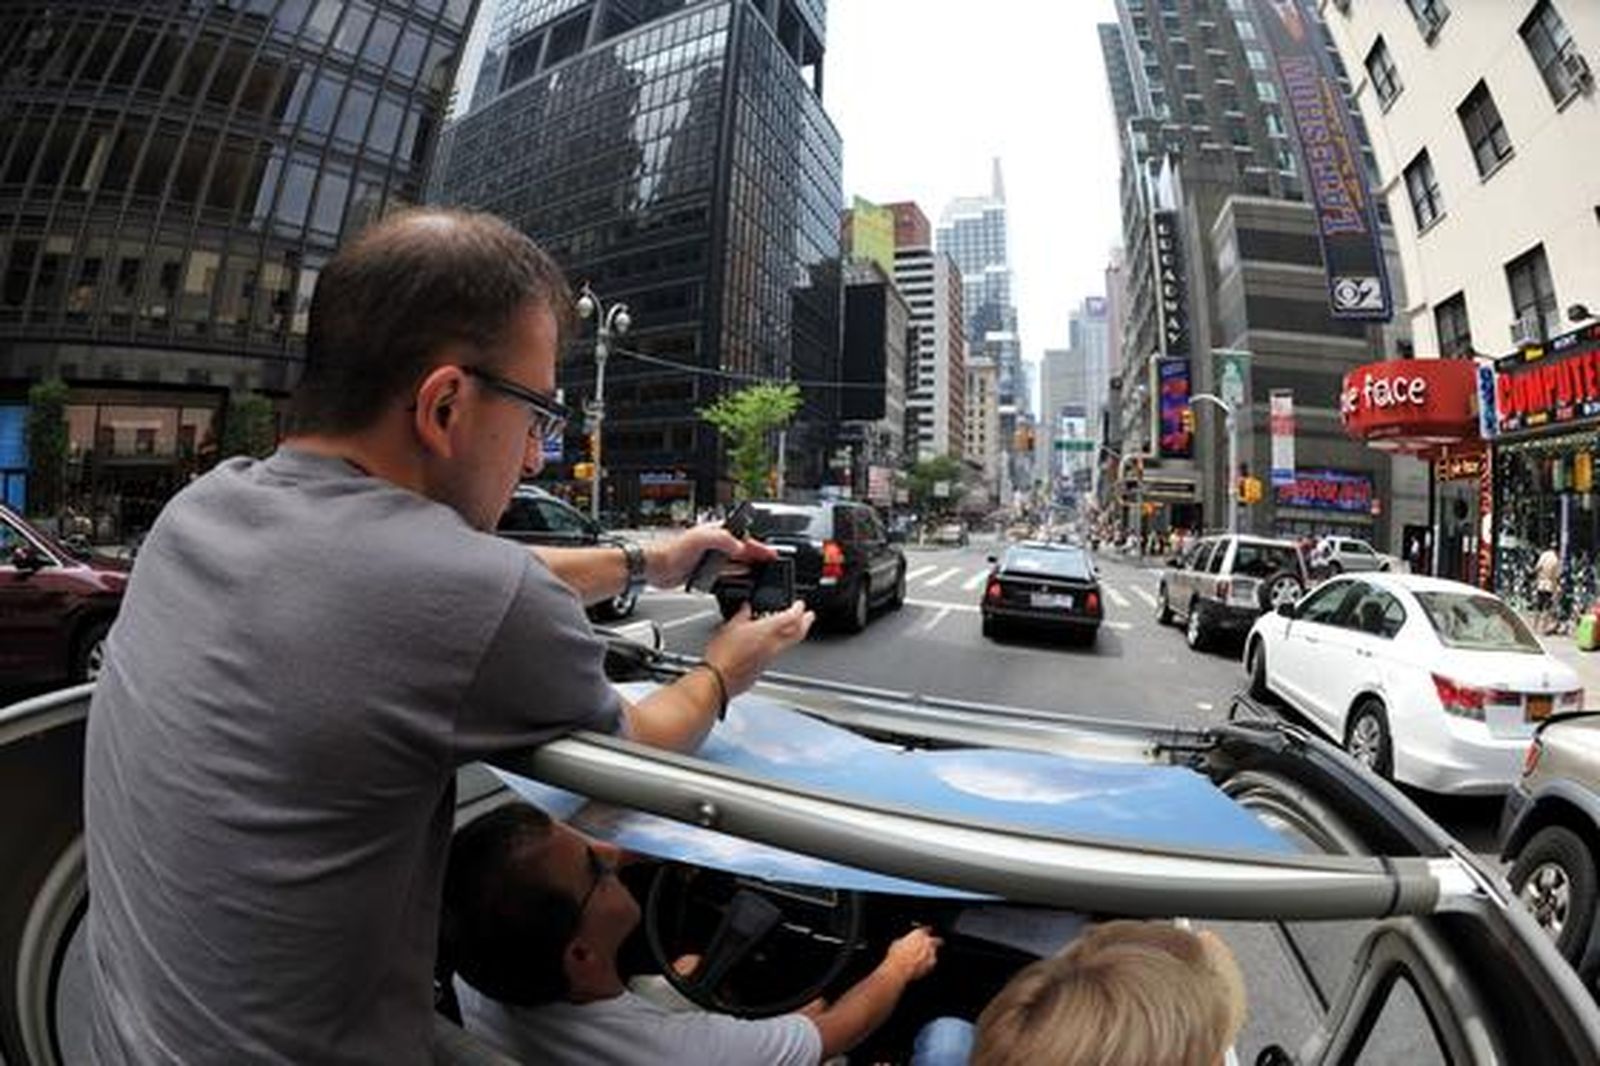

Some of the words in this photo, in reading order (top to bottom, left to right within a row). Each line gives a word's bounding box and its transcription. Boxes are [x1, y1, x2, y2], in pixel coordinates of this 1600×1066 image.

[1280, 56, 1332, 143] SHOW
[1305, 143, 1368, 235] LATE
[1362, 373, 1426, 408] face
